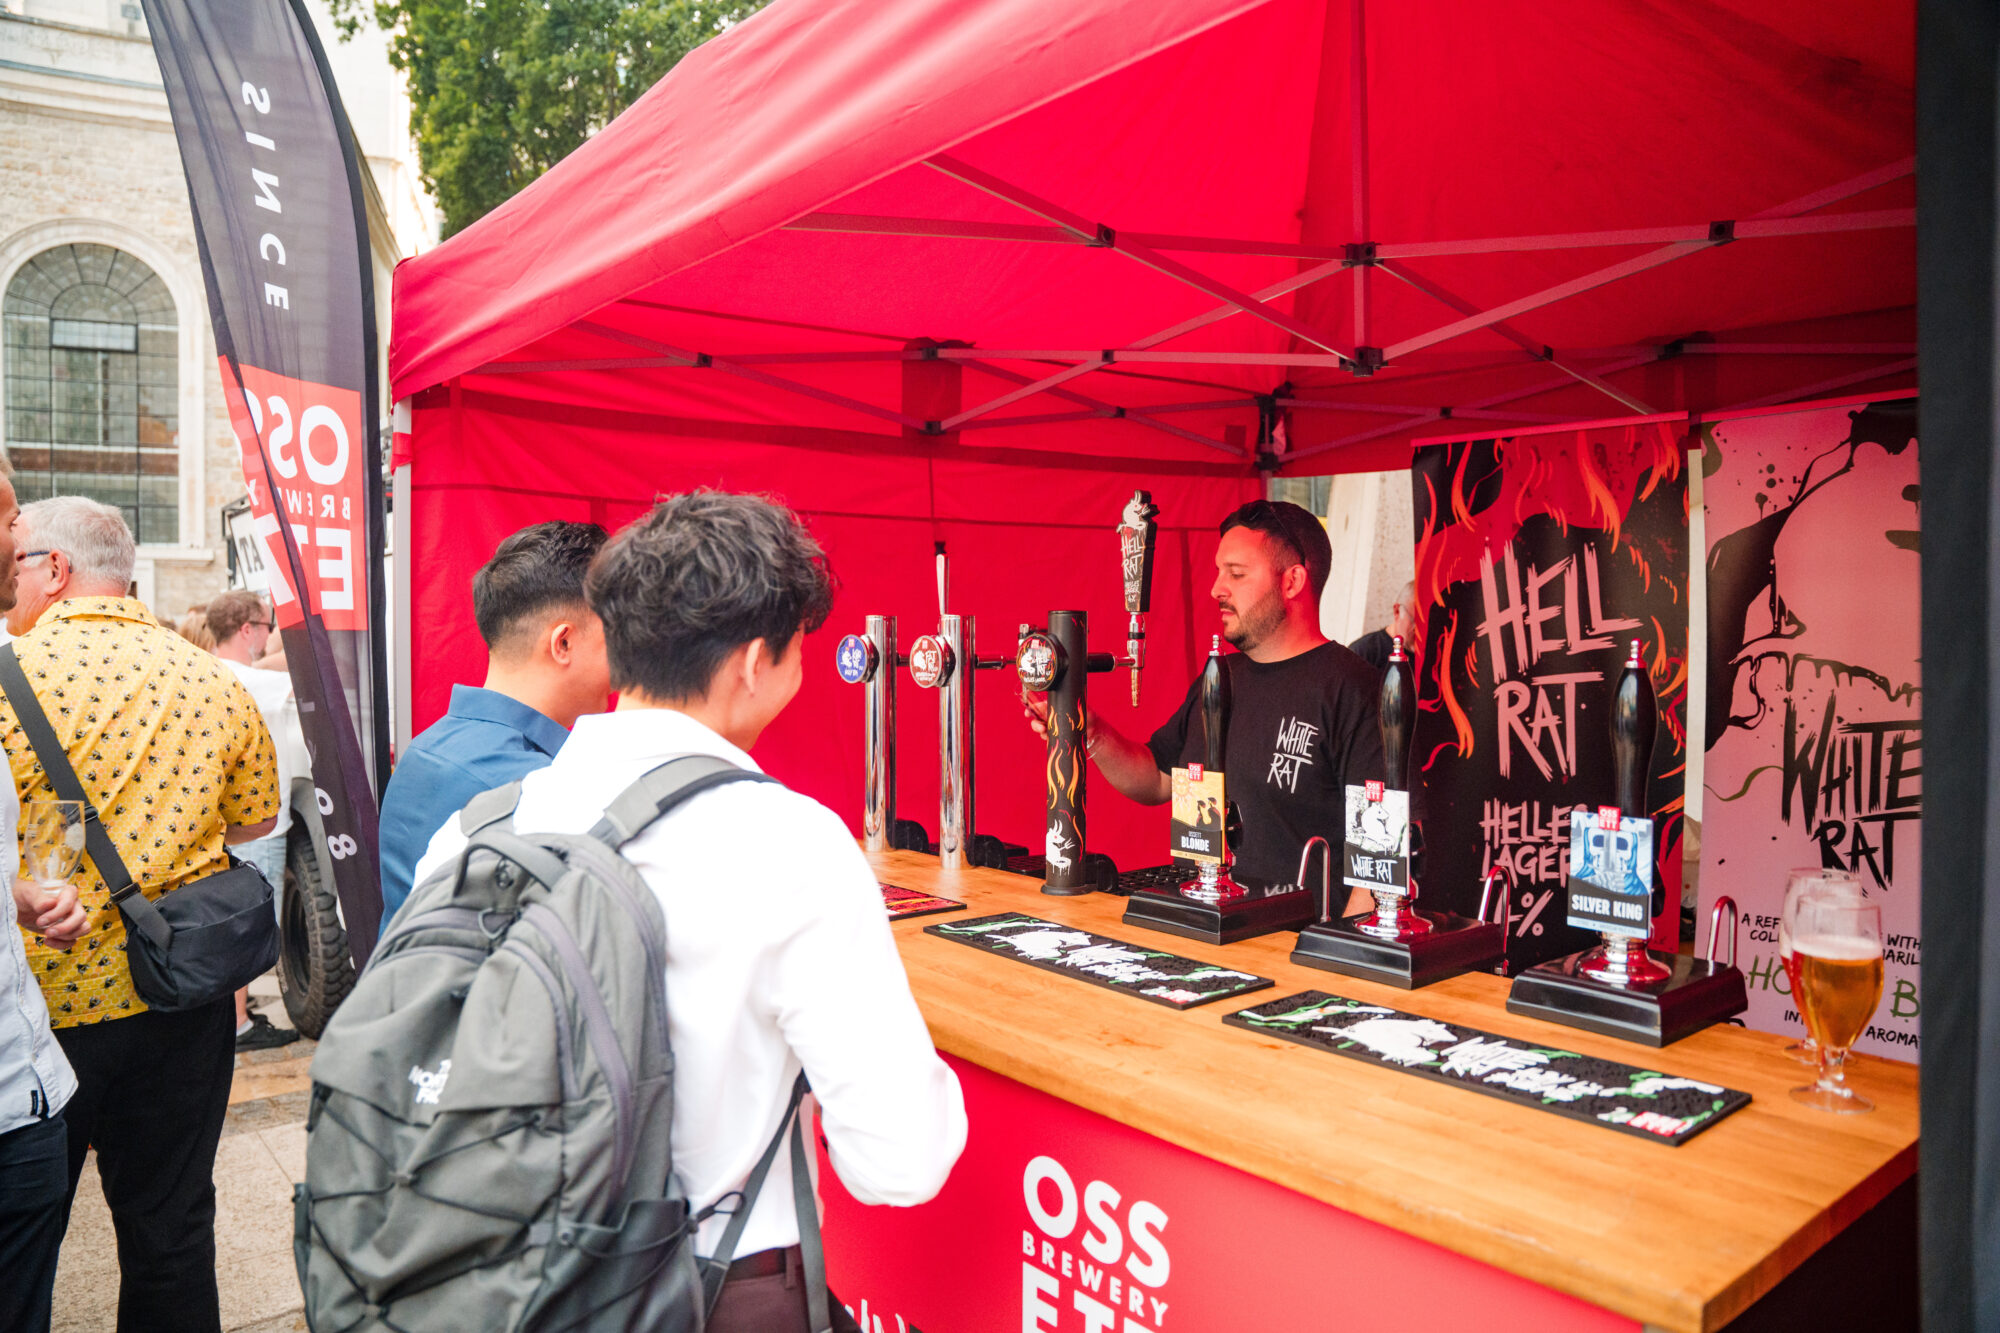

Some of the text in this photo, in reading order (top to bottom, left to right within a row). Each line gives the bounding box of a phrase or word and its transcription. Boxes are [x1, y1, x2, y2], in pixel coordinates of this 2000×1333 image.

[1121, 534, 1146, 559] HELL
[1121, 553, 1143, 580] RAT
[1475, 539, 1644, 685] HELL
[1276, 716, 1319, 758] WHITE
[1493, 671, 1604, 782] RAT
[1267, 753, 1314, 794] RAT
[1782, 688, 1922, 836] WHITE
[1366, 782, 1380, 790] OSS
[1366, 792, 1381, 800] ETT
[1599, 819, 1618, 829] ETT
[1600, 808, 1618, 818] OSS
[1181, 835, 1210, 852] BLONDE
[1810, 810, 1922, 897] RAT
[1350, 853, 1399, 884] WHITE RAT
[1571, 894, 1643, 921] SILVER KING
[1741, 913, 1751, 927] A
[1023, 1155, 1170, 1288] OSS
[1022, 1229, 1169, 1328] BREWERY
